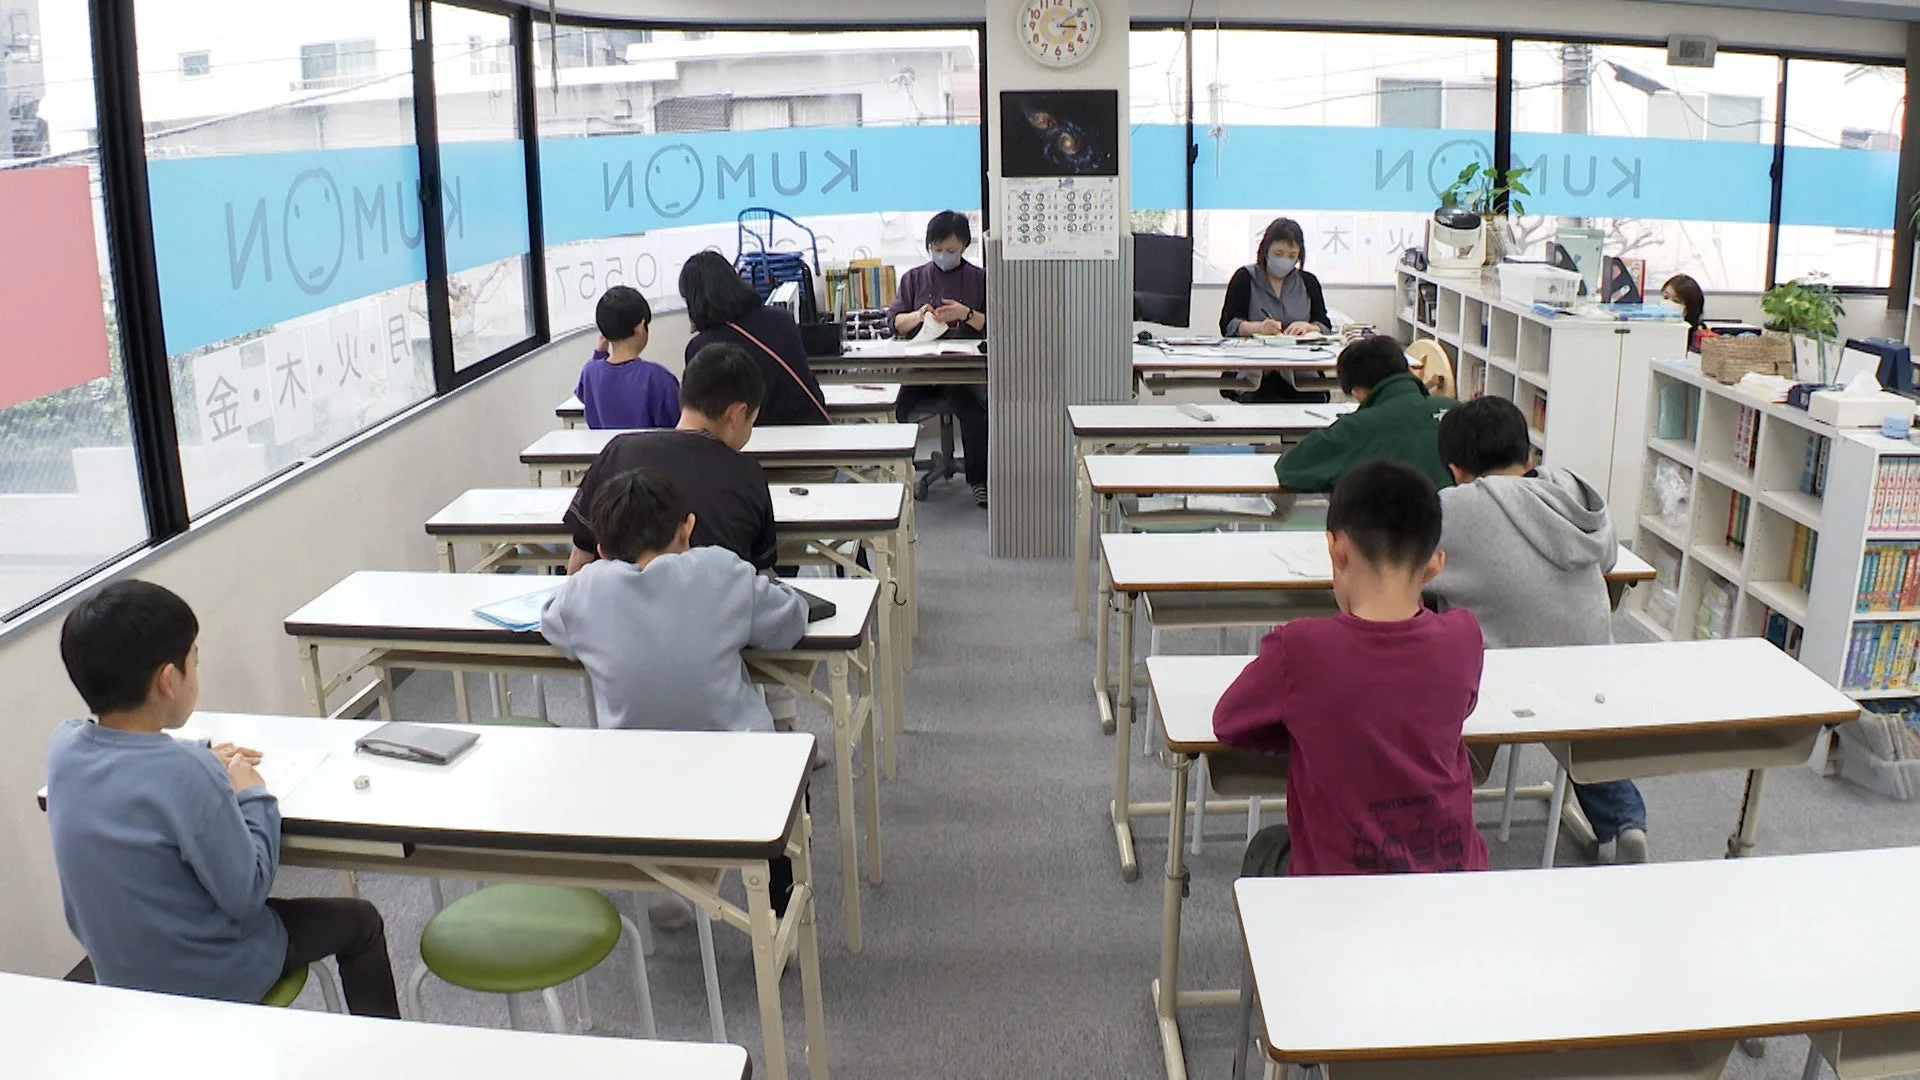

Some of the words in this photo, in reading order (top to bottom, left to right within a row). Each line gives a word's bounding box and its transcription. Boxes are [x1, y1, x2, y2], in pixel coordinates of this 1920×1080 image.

[1030, 9, 1041, 19] 10
[1029, 21, 1036, 31] 9
[1081, 21, 1087, 31] 3
[1032, 33, 1039, 43] 8
[1077, 34, 1084, 43] 4
[1041, 43, 1048, 53] 7
[1055, 46, 1062, 56] 6
[1067, 42, 1075, 52] 5
